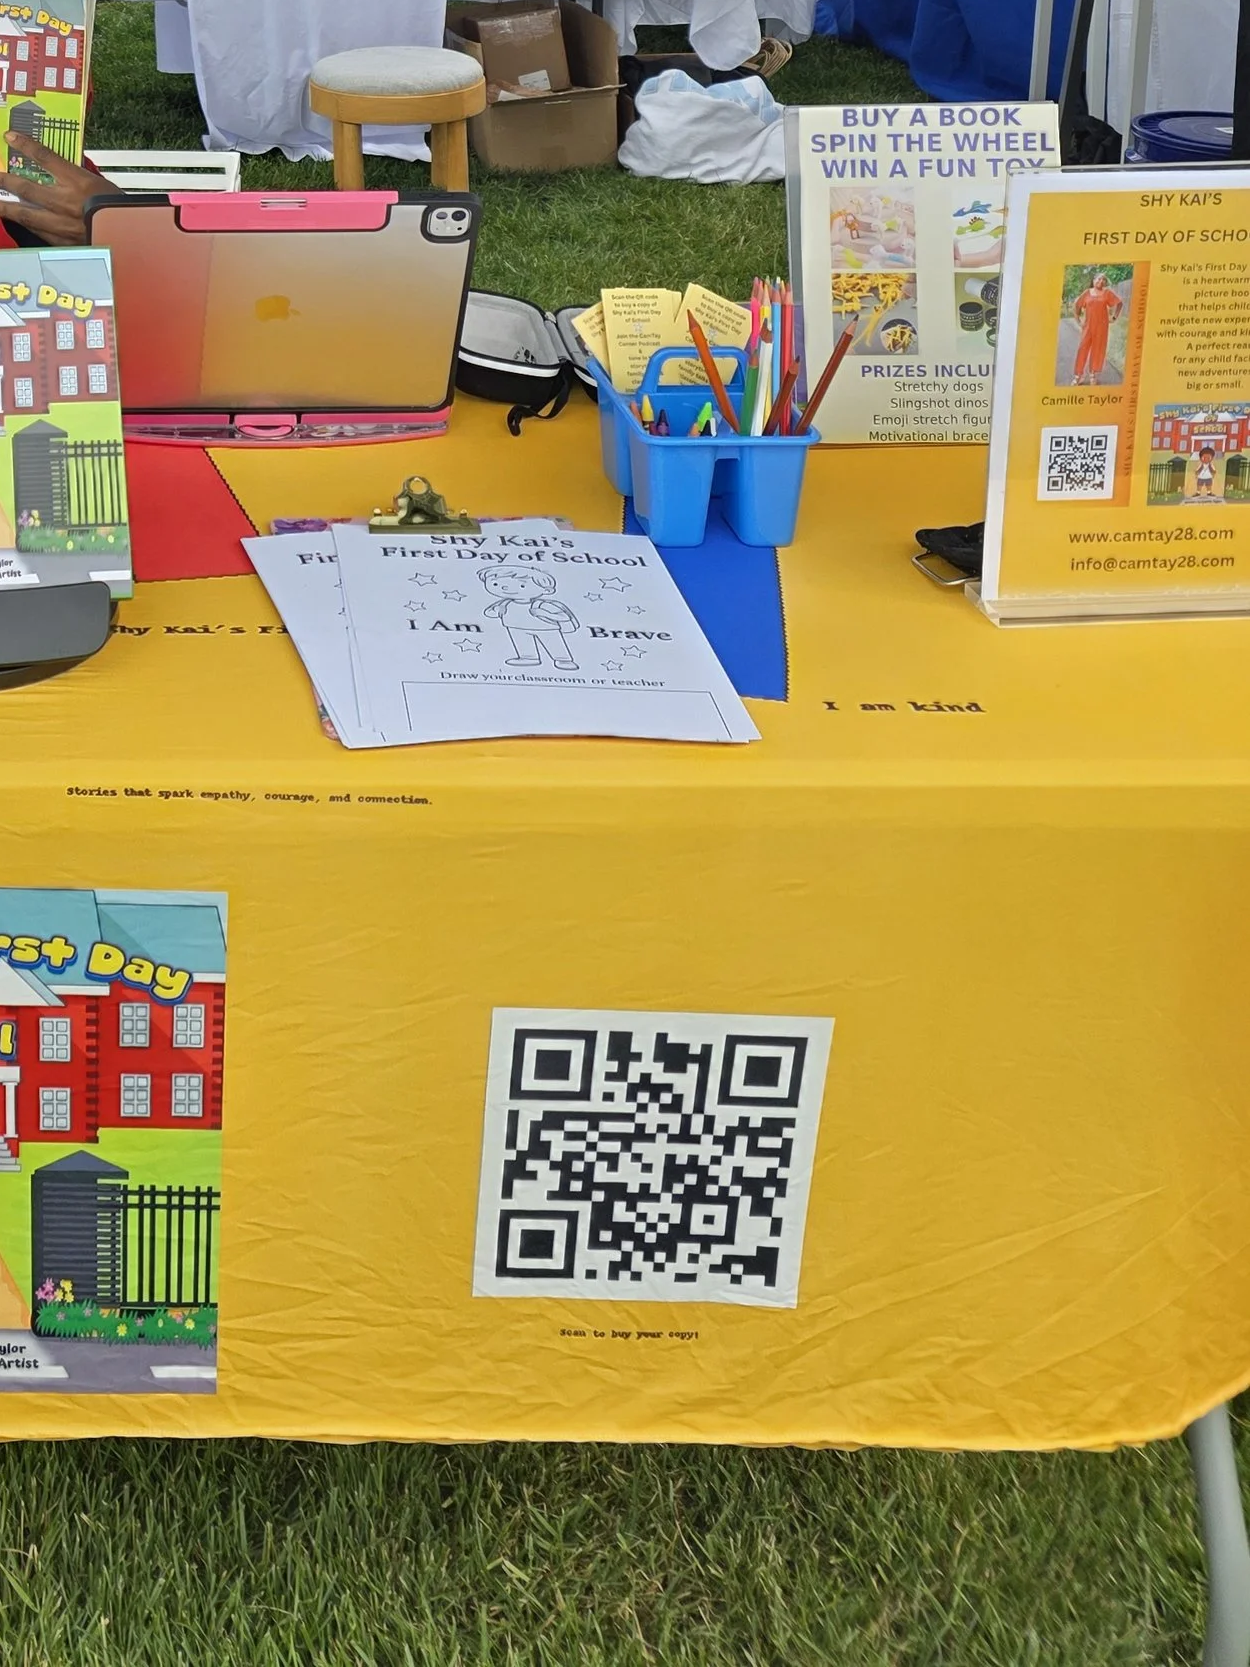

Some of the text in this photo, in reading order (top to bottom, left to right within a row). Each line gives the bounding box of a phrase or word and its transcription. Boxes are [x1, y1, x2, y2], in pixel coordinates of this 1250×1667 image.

[36, 11, 73, 36] Day
[842, 107, 1022, 128] BUY A BOOK
[810, 132, 1055, 154] SPIN THE WHEEL
[821, 158, 1045, 179] WIN A FUN TOY
[1140, 192, 1223, 207] SHY KAI'S
[1083, 229, 1250, 245] FIRST DAY OF SCHO
[1160, 264, 1178, 274] Shy
[1205, 263, 1226, 272] First
[1228, 262, 1248, 273] Day
[1194, 289, 1229, 299] picture
[37, 284, 95, 318] Day
[1178, 302, 1226, 312] that helps
[1160, 317, 1222, 327] navigate new
[1156, 328, 1238, 339] with courage and
[1195, 342, 1230, 352] perfect
[1173, 355, 1232, 365] for any child
[861, 364, 996, 377] PRIZES INCLU
[1178, 369, 1197, 377] new
[894, 381, 984, 394] Stretchy dogs
[1186, 381, 1201, 391] big
[890, 397, 989, 411] Slingshot dinos
[1041, 394, 1123, 406] Camille Taylor
[873, 414, 991, 427] Emoji stretch figur
[869, 430, 989, 442] Motivational brace
[430, 535, 575, 548] Shy Kai's
[1068, 526, 1234, 544] www.camtay28.com
[380, 546, 649, 567] First Day of School
[1070, 555, 1235, 572] info@camtay28.com
[163, 625, 246, 634] Kai's
[406, 619, 484, 633] I Am
[586, 626, 672, 642] Brave
[440, 671, 479, 680] Draw
[611, 677, 666, 687] teacher
[822, 701, 986, 712] I am kind
[66, 786, 433, 805] Stories that spark empathy, courage, and connection.
[87, 942, 194, 1004] Day
[593, 1330, 605, 1338] to
[611, 1330, 631, 1339] buy
[636, 1331, 663, 1340] your
[668, 1331, 698, 1340] copy!
